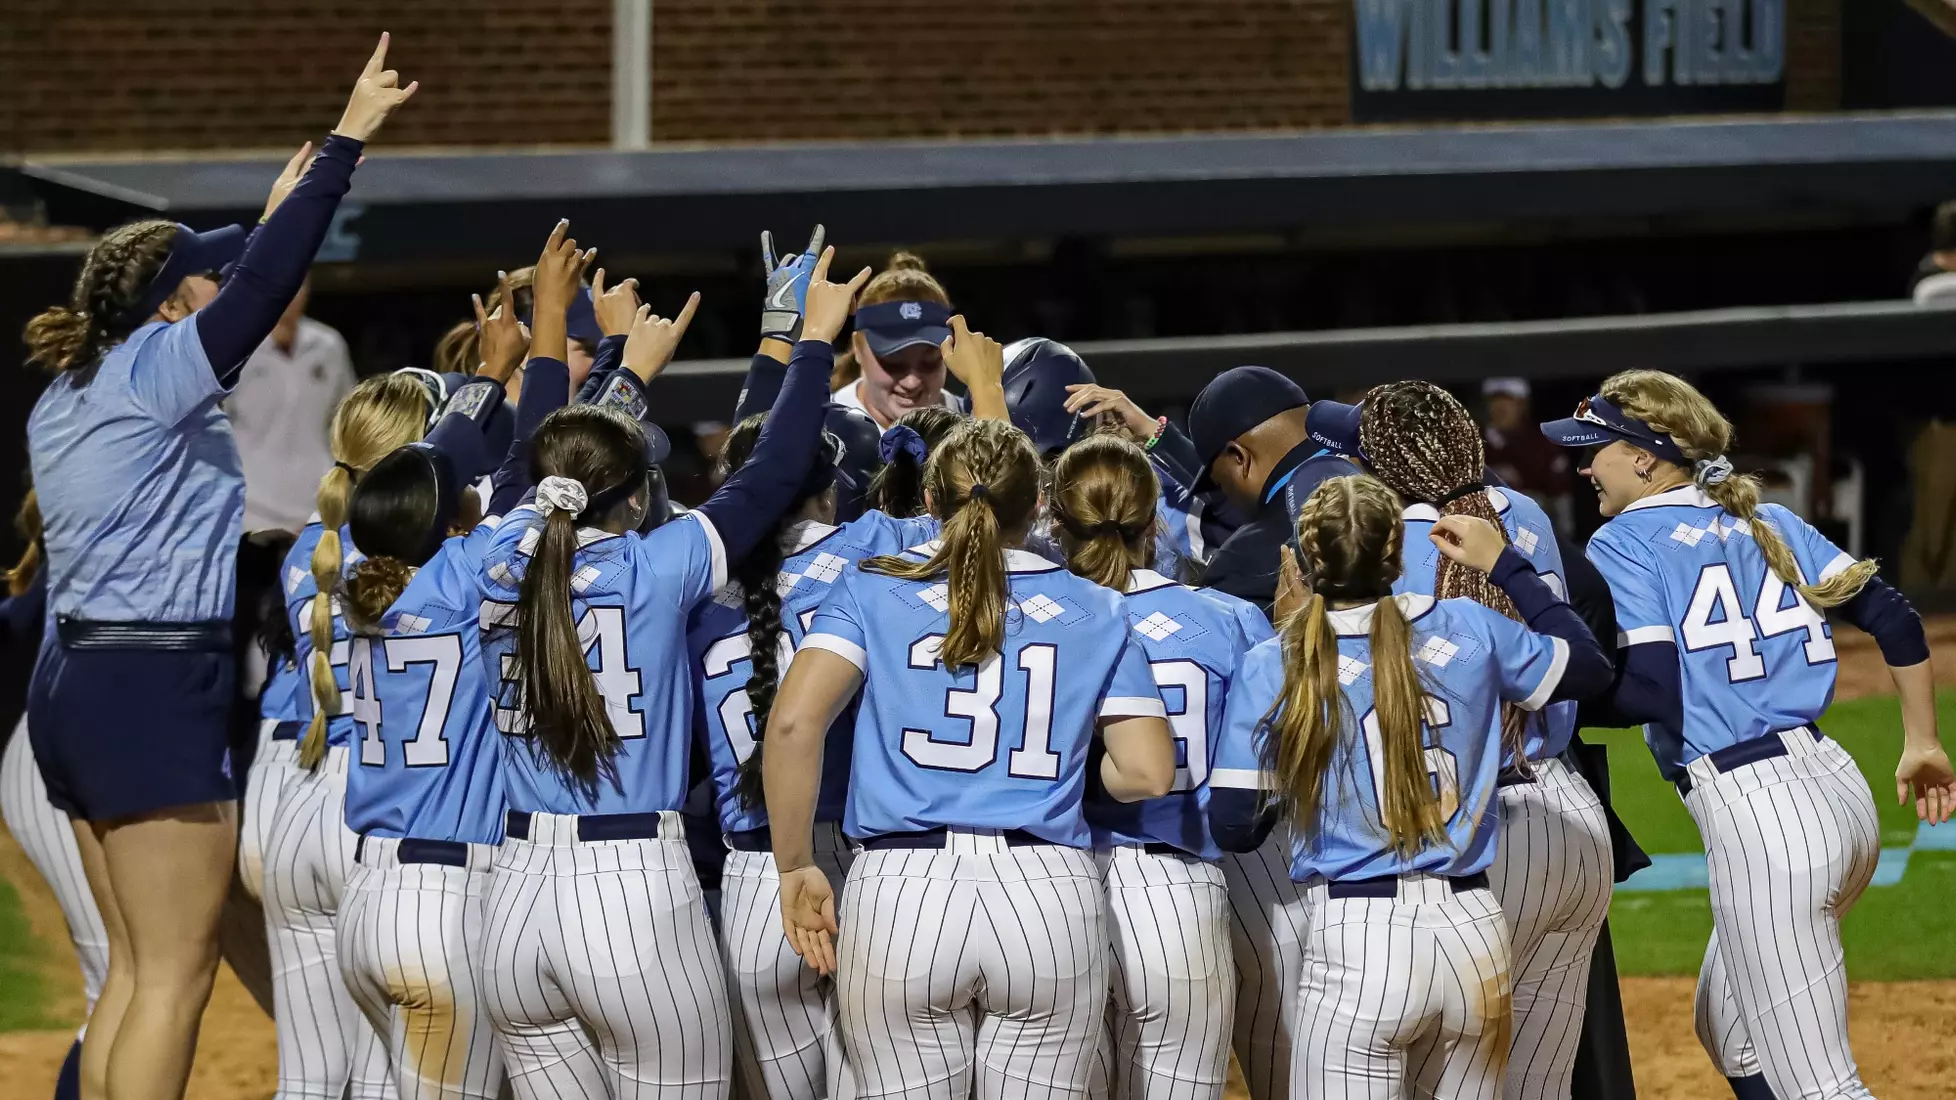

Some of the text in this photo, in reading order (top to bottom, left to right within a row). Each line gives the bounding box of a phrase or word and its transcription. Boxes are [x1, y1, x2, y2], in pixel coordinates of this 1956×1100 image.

[1357, 0, 1786, 90] WILLIAMS FIELD
[1311, 431, 1343, 450] SOFTBALL
[1562, 432, 1599, 442] SOFTBALL
[1679, 551, 1838, 685] 44
[349, 632, 465, 768] 47
[899, 632, 1061, 782] 31
